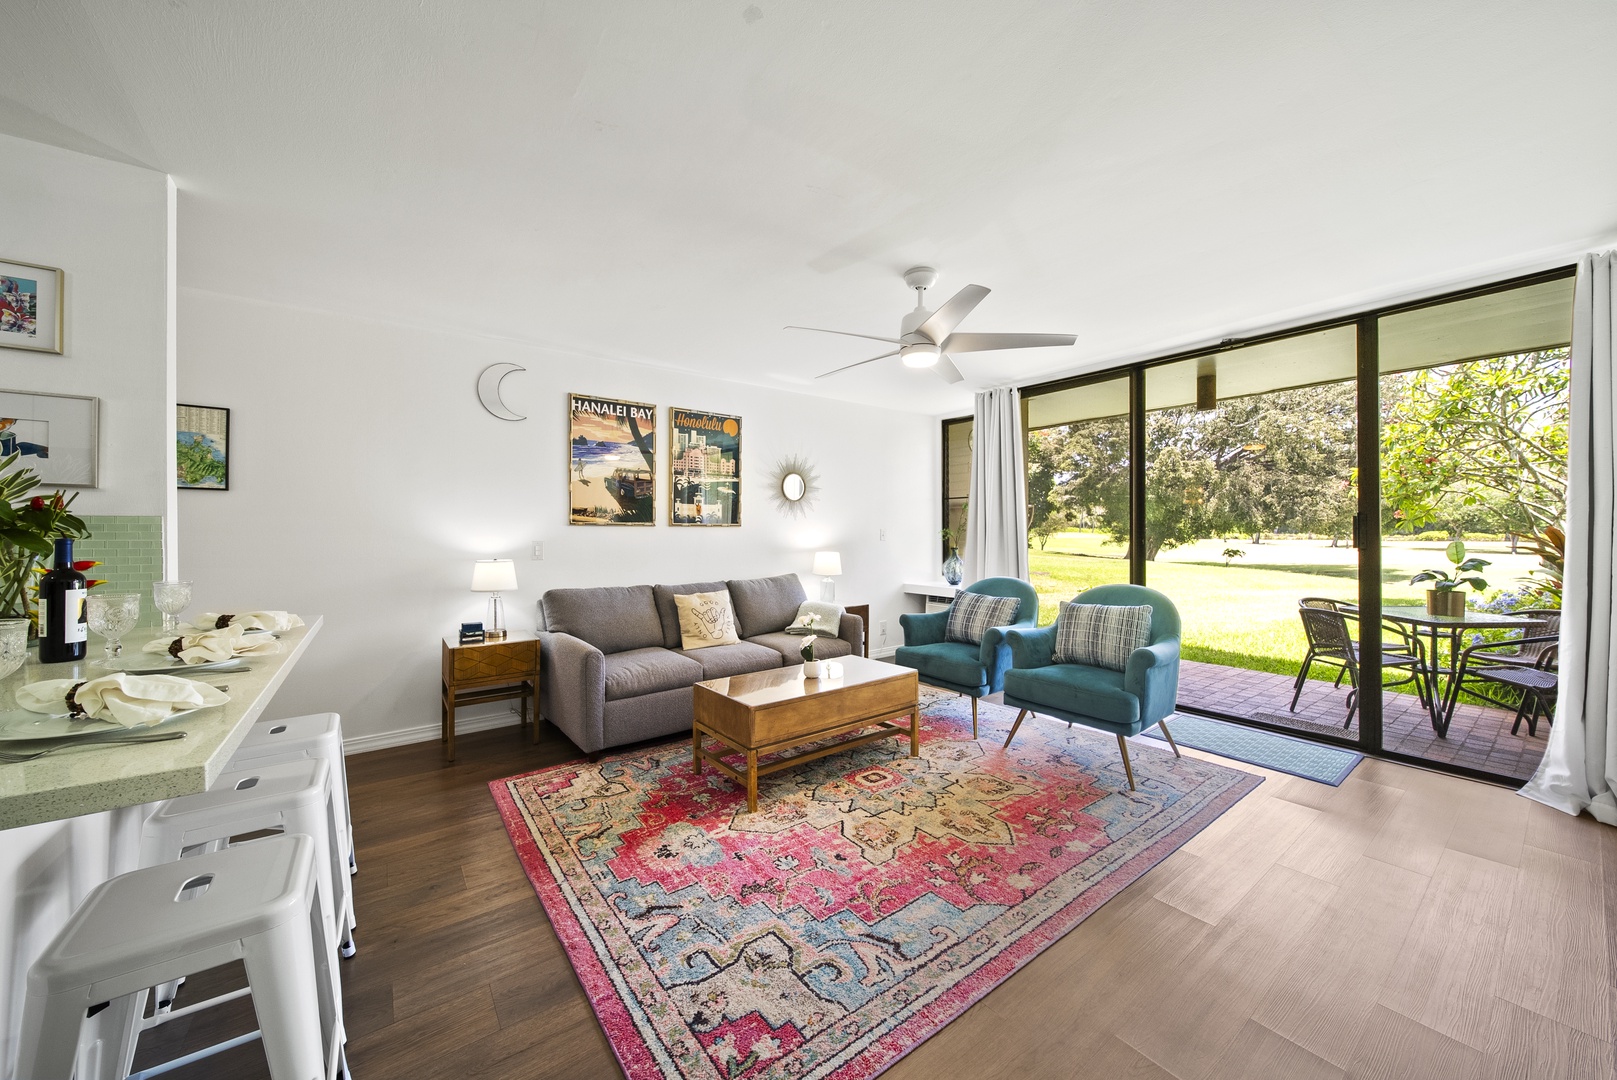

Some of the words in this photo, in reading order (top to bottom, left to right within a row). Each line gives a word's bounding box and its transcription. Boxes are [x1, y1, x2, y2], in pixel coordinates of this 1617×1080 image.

[572, 400, 627, 417] HANALEI
[630, 406, 653, 420] BAY
[675, 413, 722, 431] Honolulu
